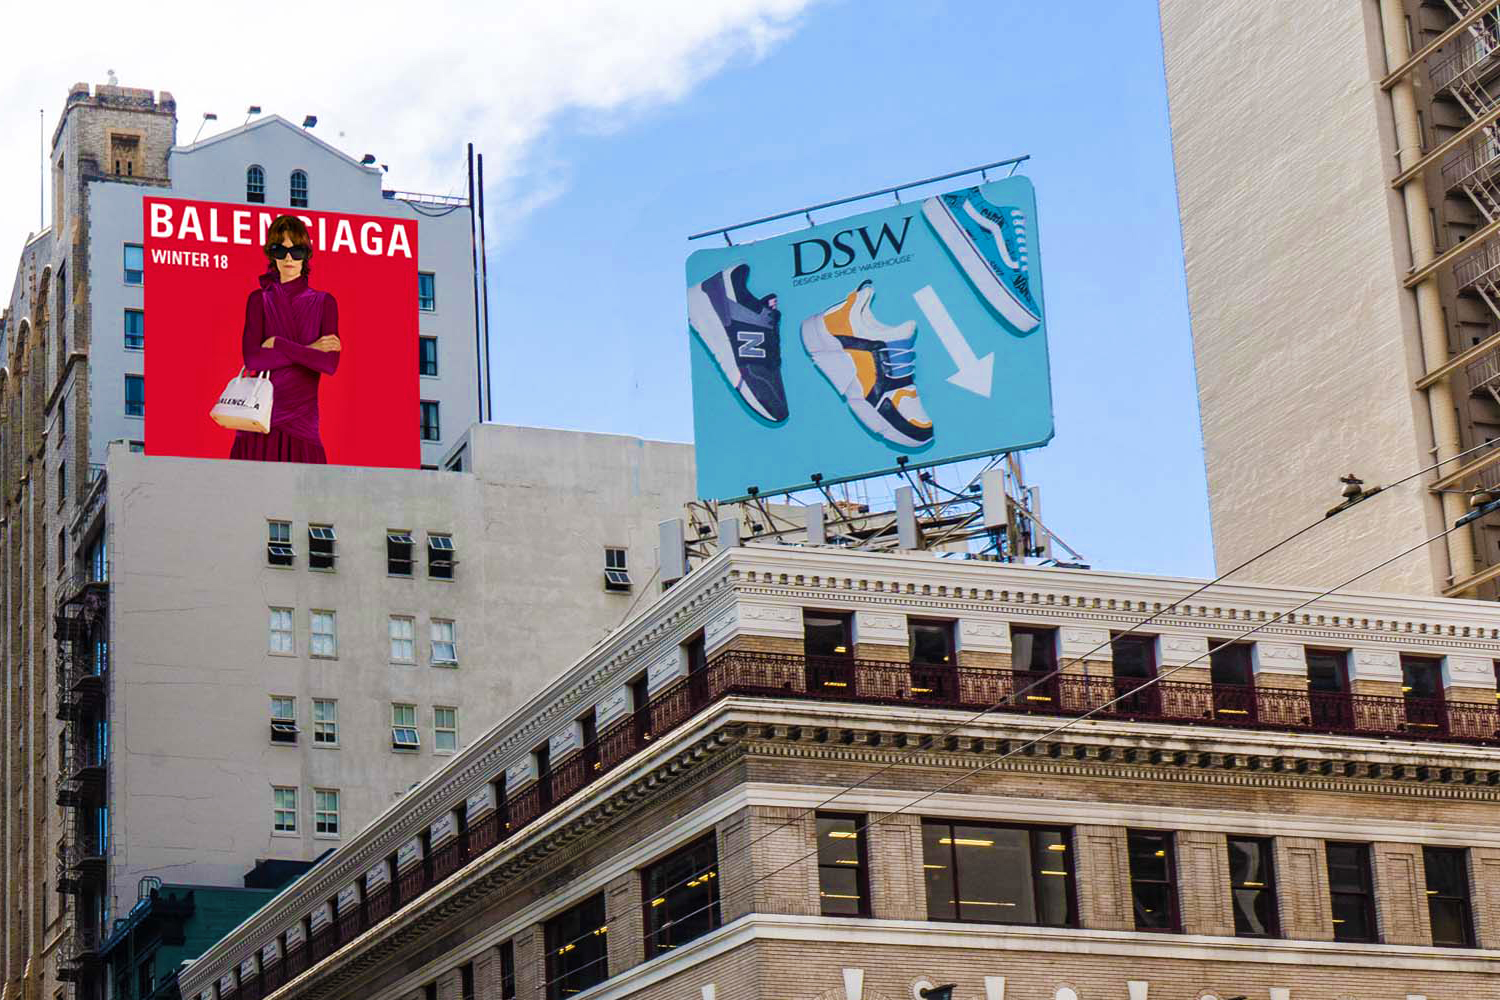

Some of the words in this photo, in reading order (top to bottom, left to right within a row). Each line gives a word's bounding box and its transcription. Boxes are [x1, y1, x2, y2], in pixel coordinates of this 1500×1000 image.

[150, 202, 412, 259] BALENIAGA
[788, 215, 914, 279] DSW
[151, 248, 209, 268] WINTER
[213, 254, 228, 269] 18
[792, 272, 833, 287] DESIGNER
[834, 266, 857, 278] SHOE
[858, 254, 911, 272] WAREHOUSE
